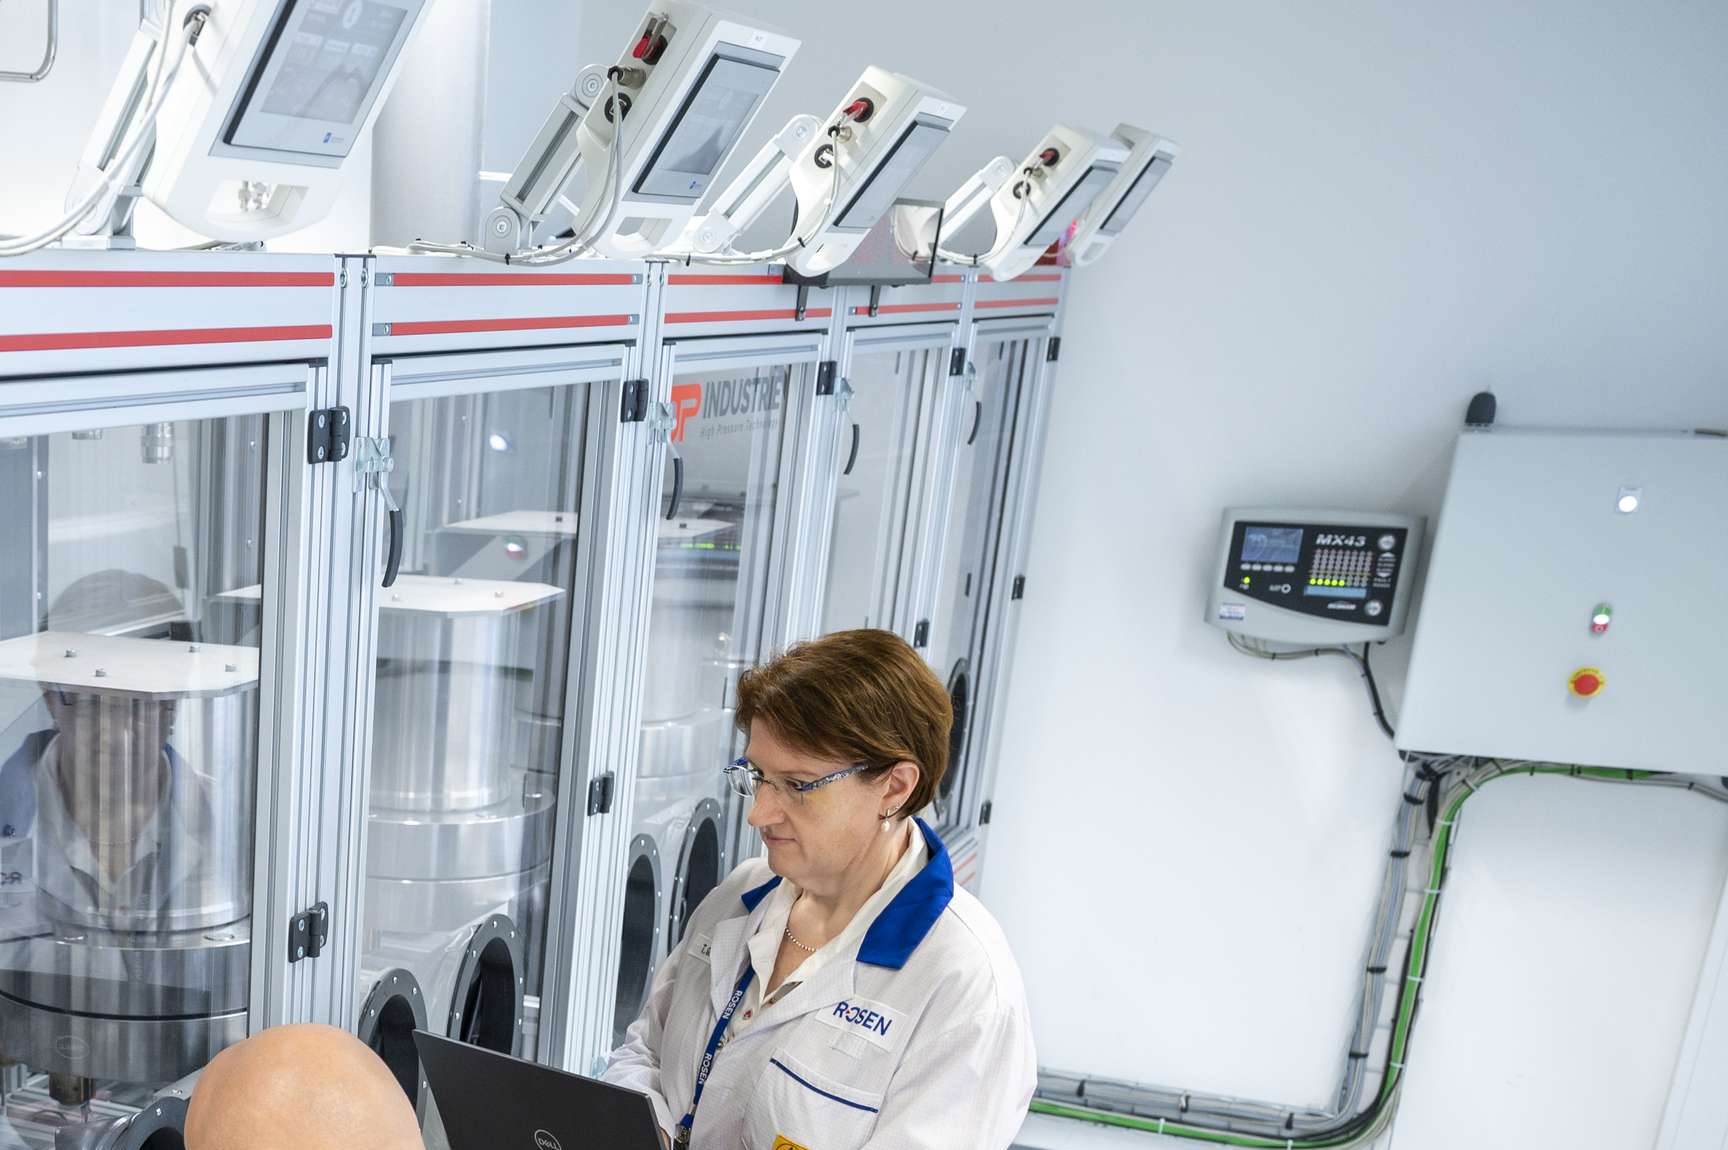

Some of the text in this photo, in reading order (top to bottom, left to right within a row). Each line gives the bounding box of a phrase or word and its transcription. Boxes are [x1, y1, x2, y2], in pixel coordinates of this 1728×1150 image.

[703, 376, 781, 418] INDUSTRIE
[1316, 534, 1367, 547] MX43
[722, 990, 743, 1020] ROSEN
[833, 1001, 893, 1036] ROSEN
[698, 1053, 712, 1085] ROSEN
